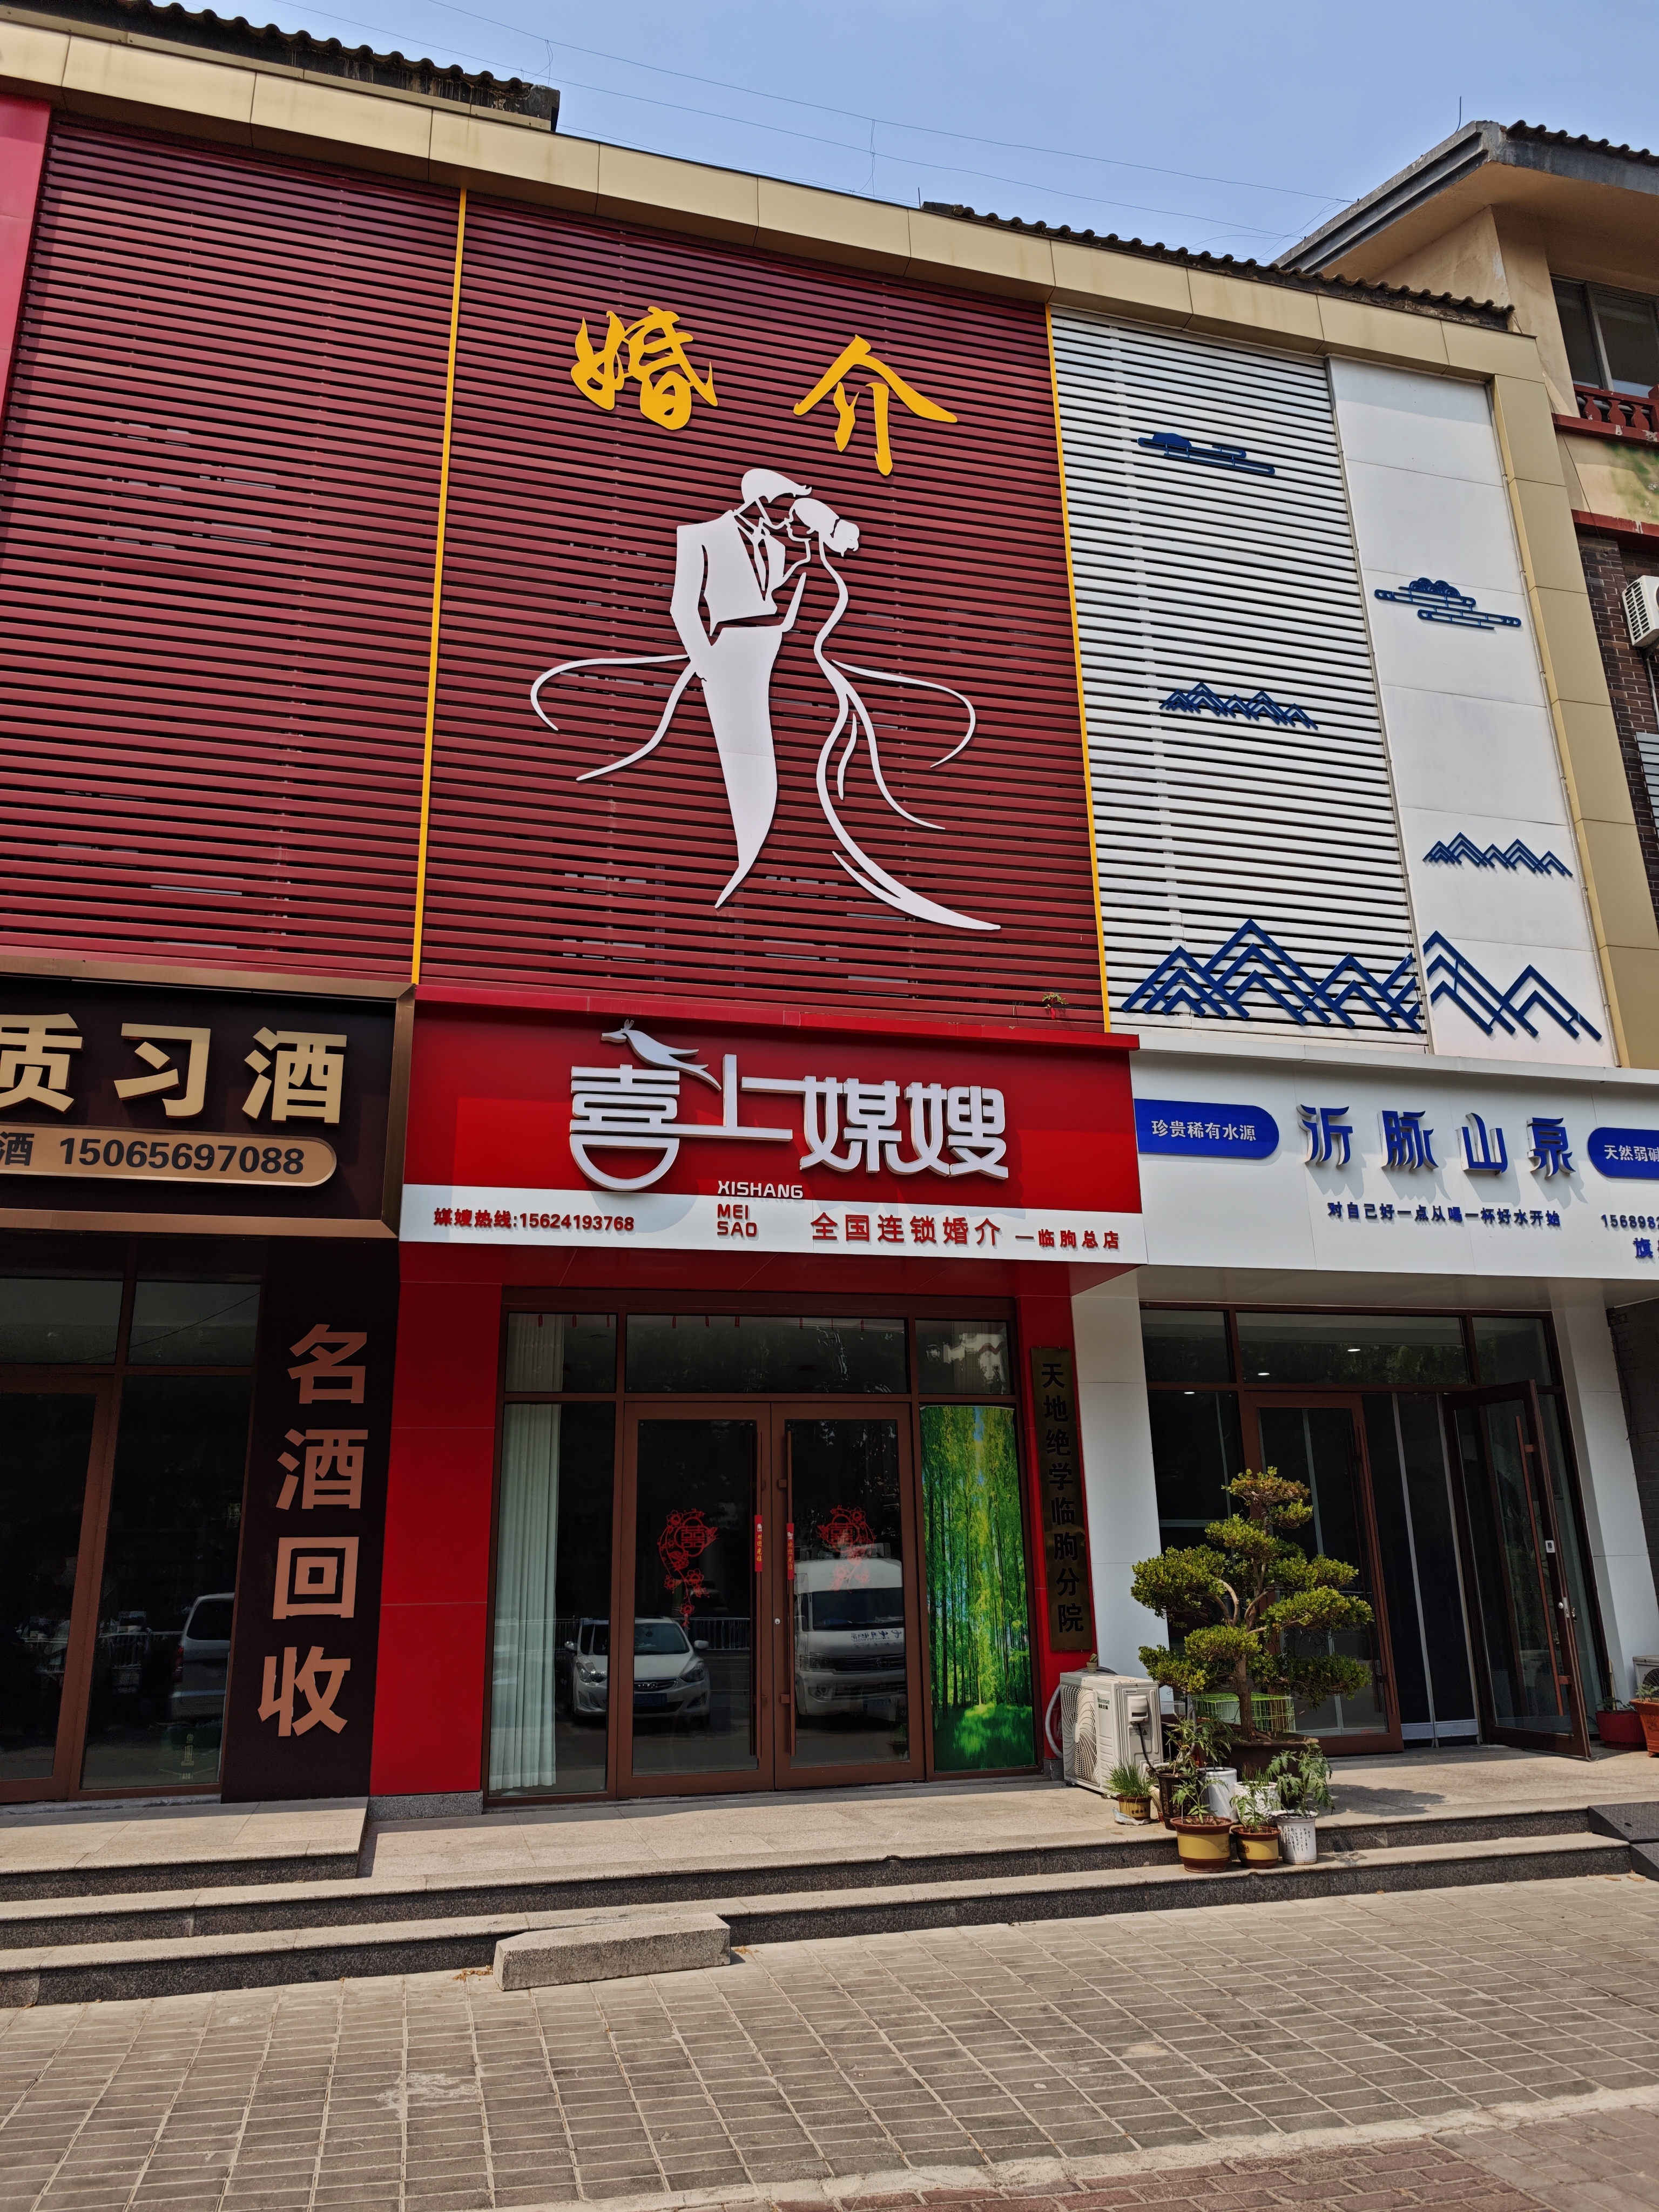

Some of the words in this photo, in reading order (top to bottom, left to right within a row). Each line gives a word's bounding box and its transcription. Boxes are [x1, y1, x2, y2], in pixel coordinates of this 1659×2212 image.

[570, 1054, 1009, 1191] 喜上媒嫂
[1151, 1120, 1256, 1141] 珍贵稀有水源
[1297, 1104, 1576, 1178] 沂脉山泉
[59, 1138, 305, 1175] 15065697088
[717, 1181, 804, 1199] XISHANG
[717, 1204, 748, 1219] MEI
[1327, 1201, 1562, 1227] 对自己好一点从喝一杯好水开始
[1601, 1215, 1659, 1230] 156898
[717, 1221, 757, 1237] SAO
[811, 1212, 1001, 1246] 全国连锁婚介
[1633, 1238, 1659, 1259] 旗
[1042, 1363, 1084, 1633] 天地绝学临朐分院
[258, 1324, 368, 1737] 名酒回收
